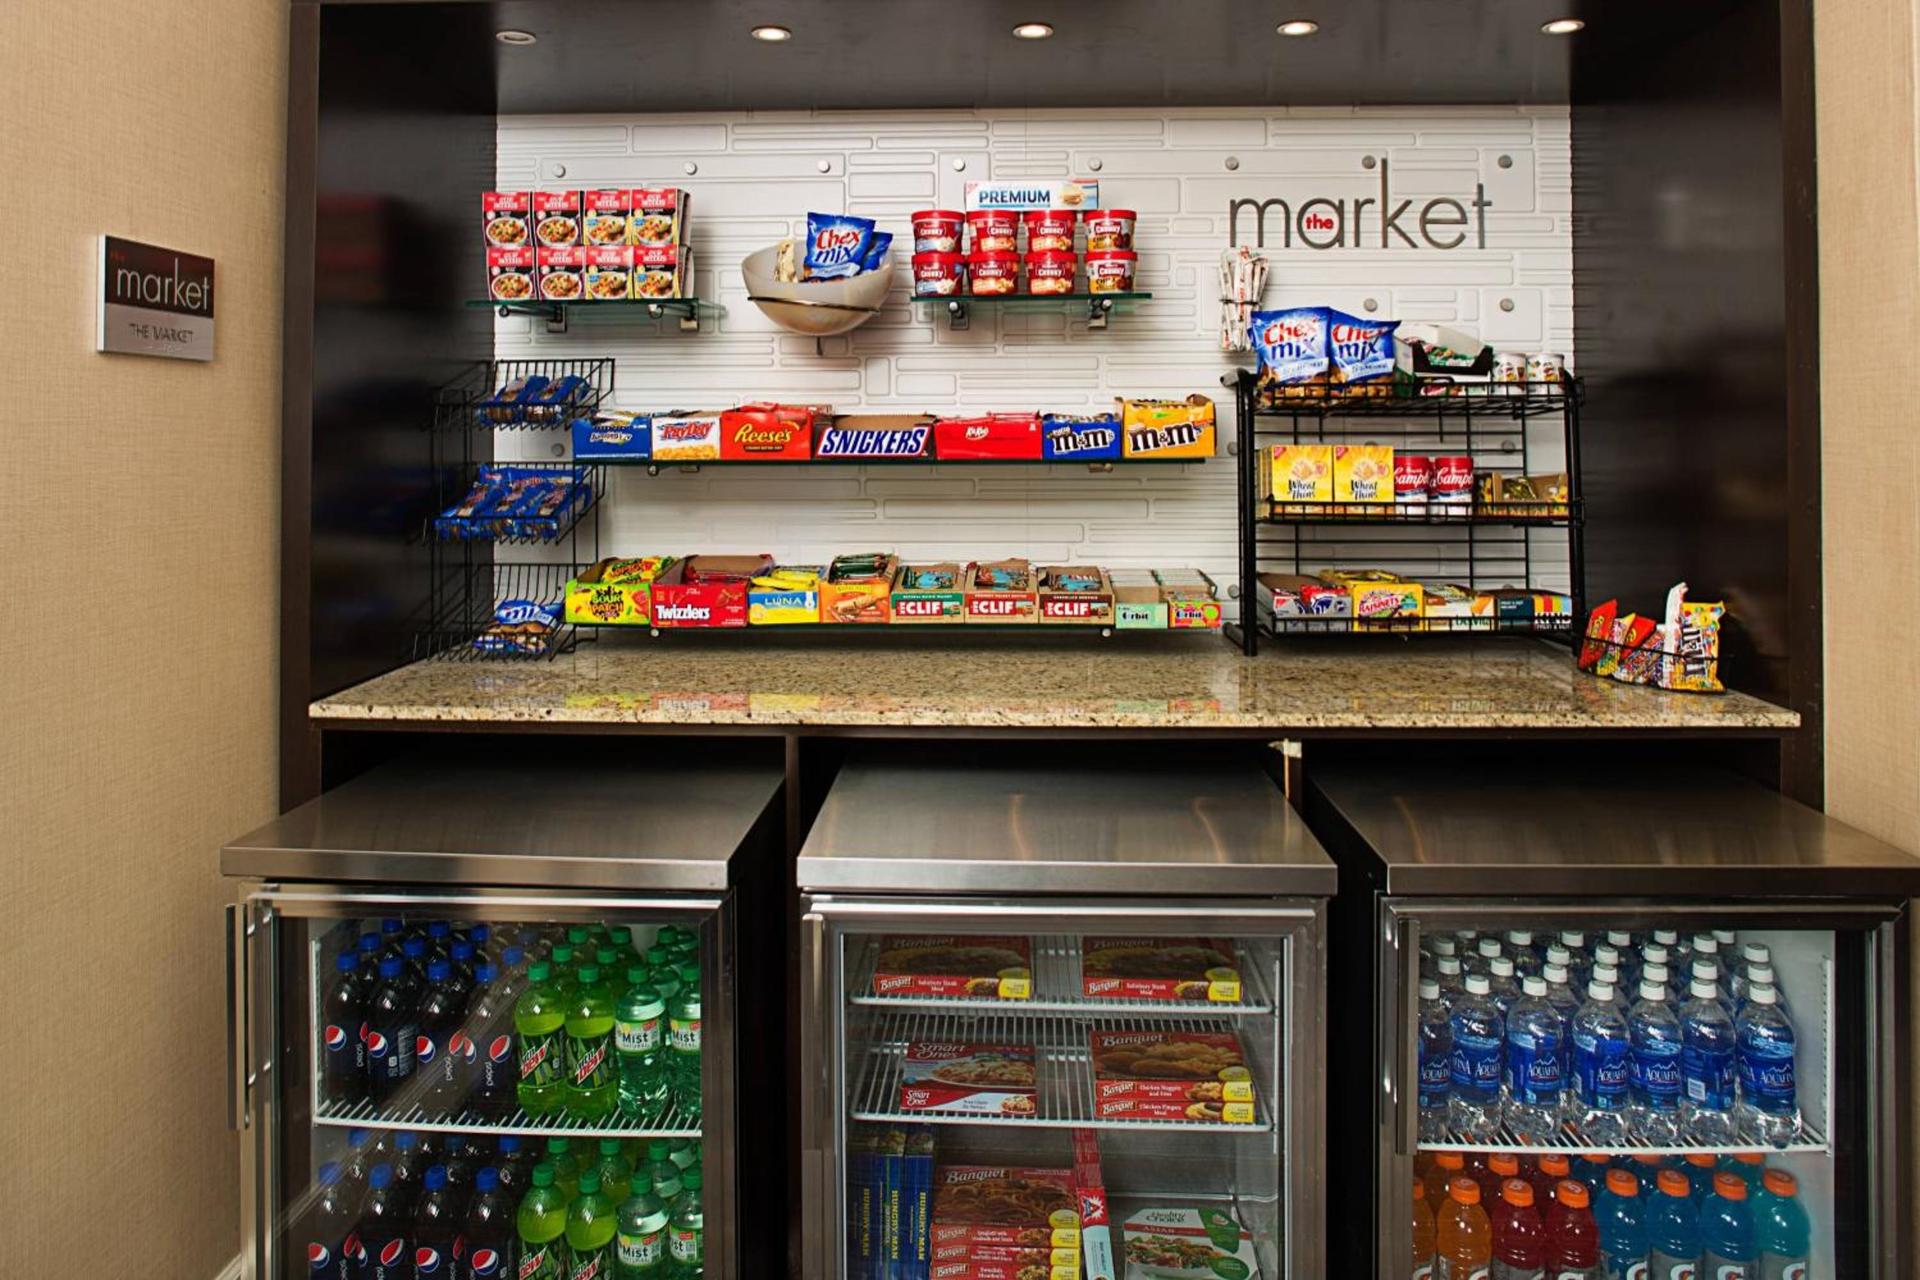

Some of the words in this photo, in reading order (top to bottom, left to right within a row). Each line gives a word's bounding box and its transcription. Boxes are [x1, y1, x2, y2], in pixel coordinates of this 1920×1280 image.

[978, 190, 1050, 203] PREMIUM
[1230, 158, 1492, 249] market
[1305, 214, 1334, 230] the
[816, 229, 862, 250] Chex
[815, 245, 853, 264] mix
[117, 258, 210, 310] market
[129, 323, 149, 339] THE
[153, 325, 194, 344] MARKET
[1339, 335, 1379, 361] mix
[735, 423, 792, 443] Reese's
[820, 428, 926, 455] SNICKERS
[1288, 479, 1316, 491] Wheat
[1351, 479, 1378, 491] Wheat
[1291, 489, 1315, 500] Thins
[1353, 489, 1377, 500] Thins
[592, 603, 623, 612] PATCH
[765, 597, 802, 606] LUNA
[906, 601, 941, 614] CLIF
[979, 601, 1014, 613] CLIF
[656, 604, 710, 620] Twizzlers
[1054, 603, 1089, 615] CLIF
[622, 1031, 648, 1043] Mist
[672, 1030, 696, 1043] Mist
[1103, 1034, 1163, 1047] Banquet
[915, 1042, 966, 1052] Smart
[916, 1051, 957, 1060] Ones
[906, 1090, 930, 1099] Smart
[907, 1098, 926, 1107] Ones
[946, 1168, 1006, 1184] Banquet
[623, 1245, 648, 1257] Mist
